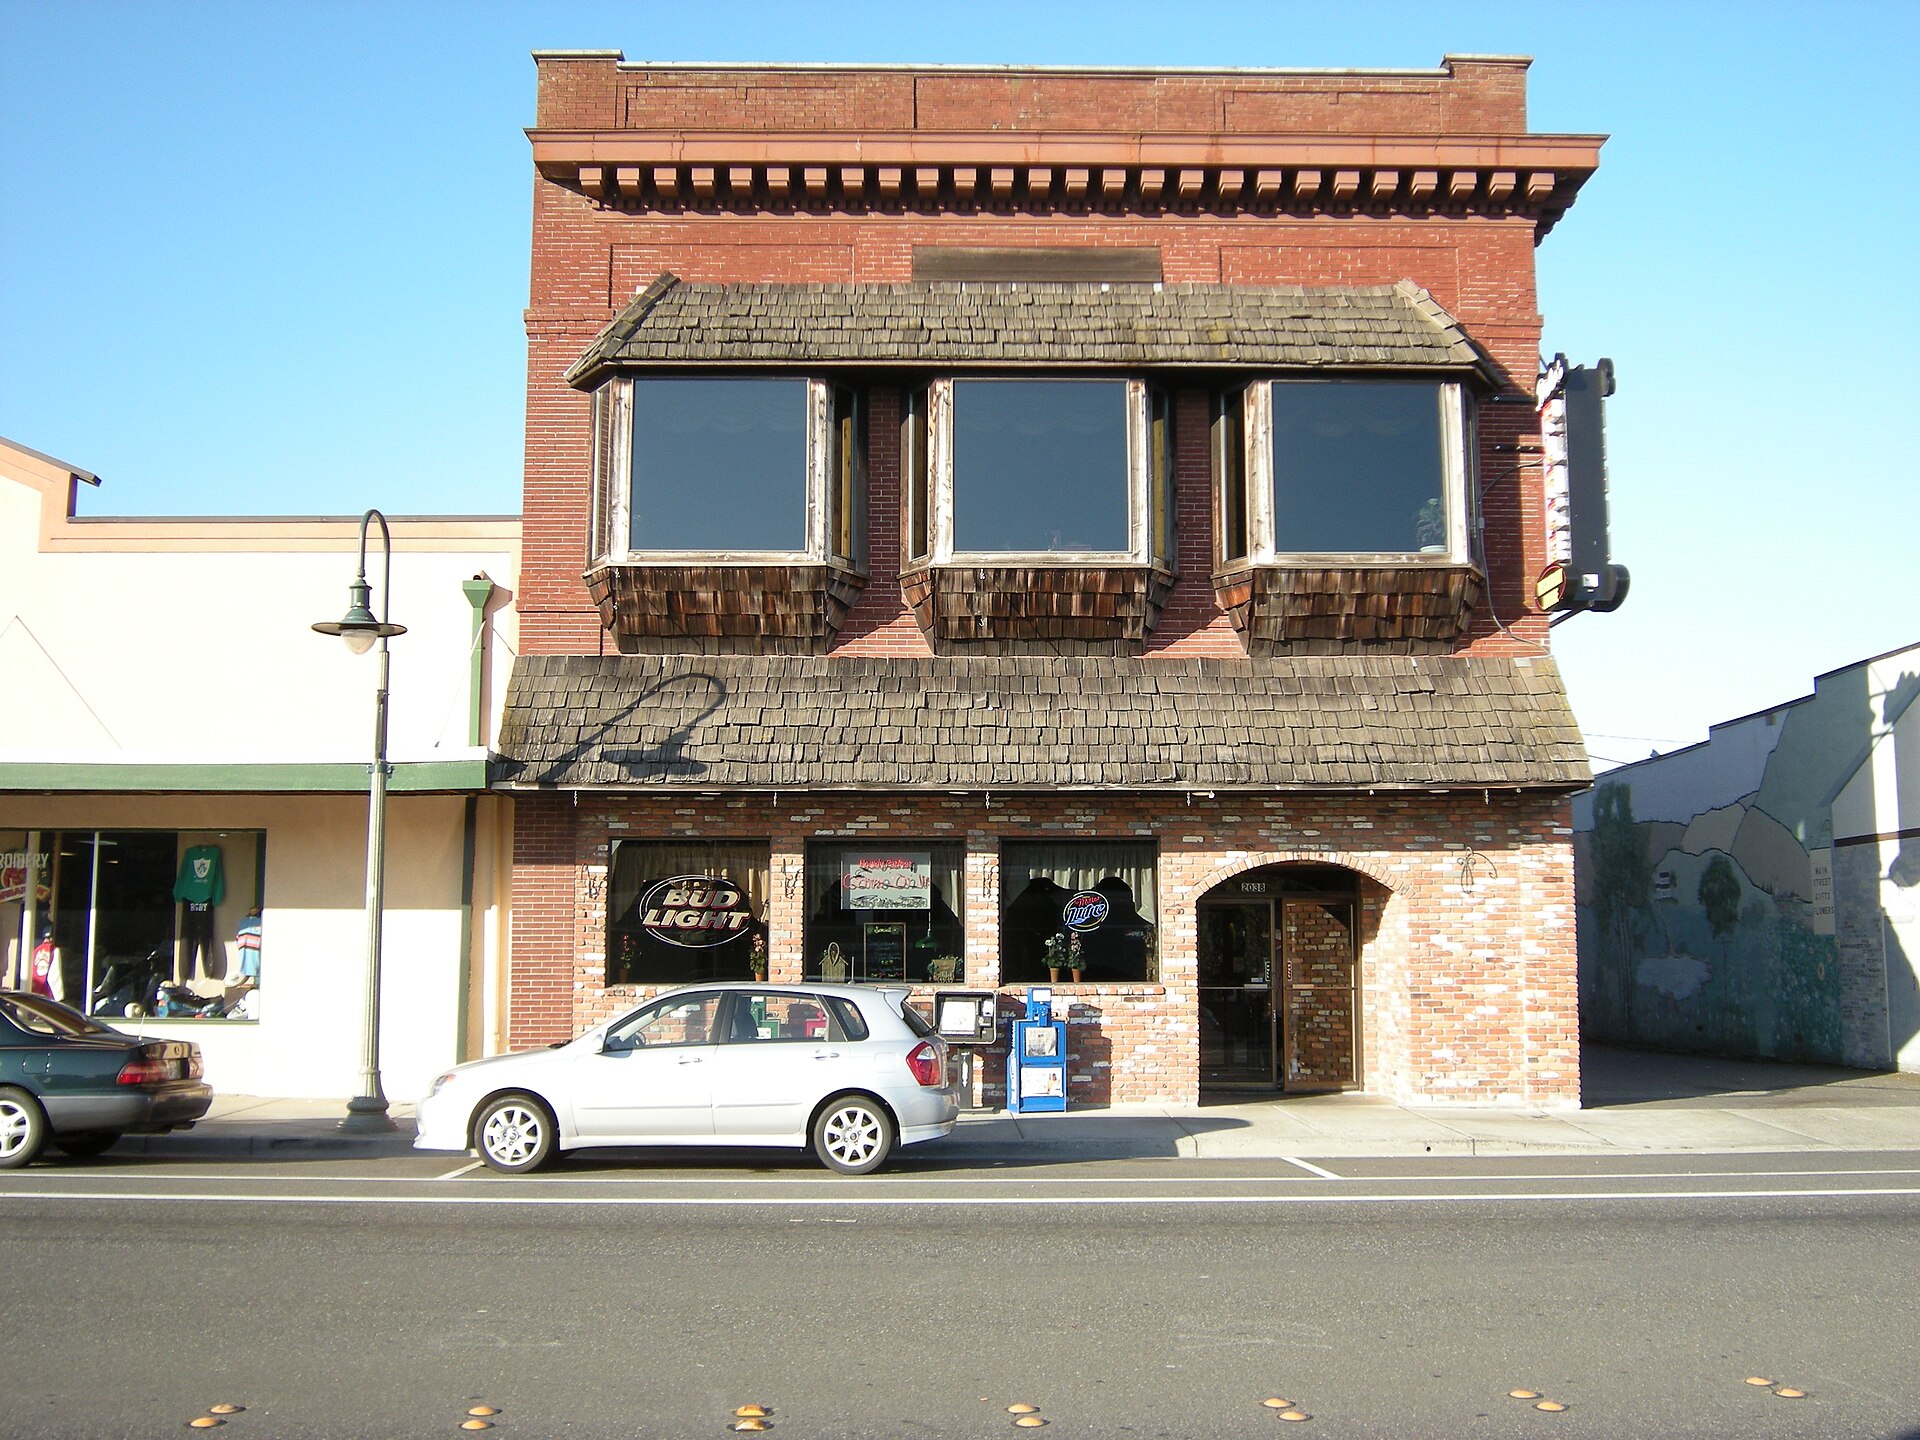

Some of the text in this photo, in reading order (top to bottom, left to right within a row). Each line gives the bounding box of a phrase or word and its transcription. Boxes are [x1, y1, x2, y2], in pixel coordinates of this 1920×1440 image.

[1242, 883, 1266, 892] 2038
[1813, 877, 1831, 887] STREET
[663, 888, 741, 909] BUD
[642, 909, 753, 931] LIGHT
